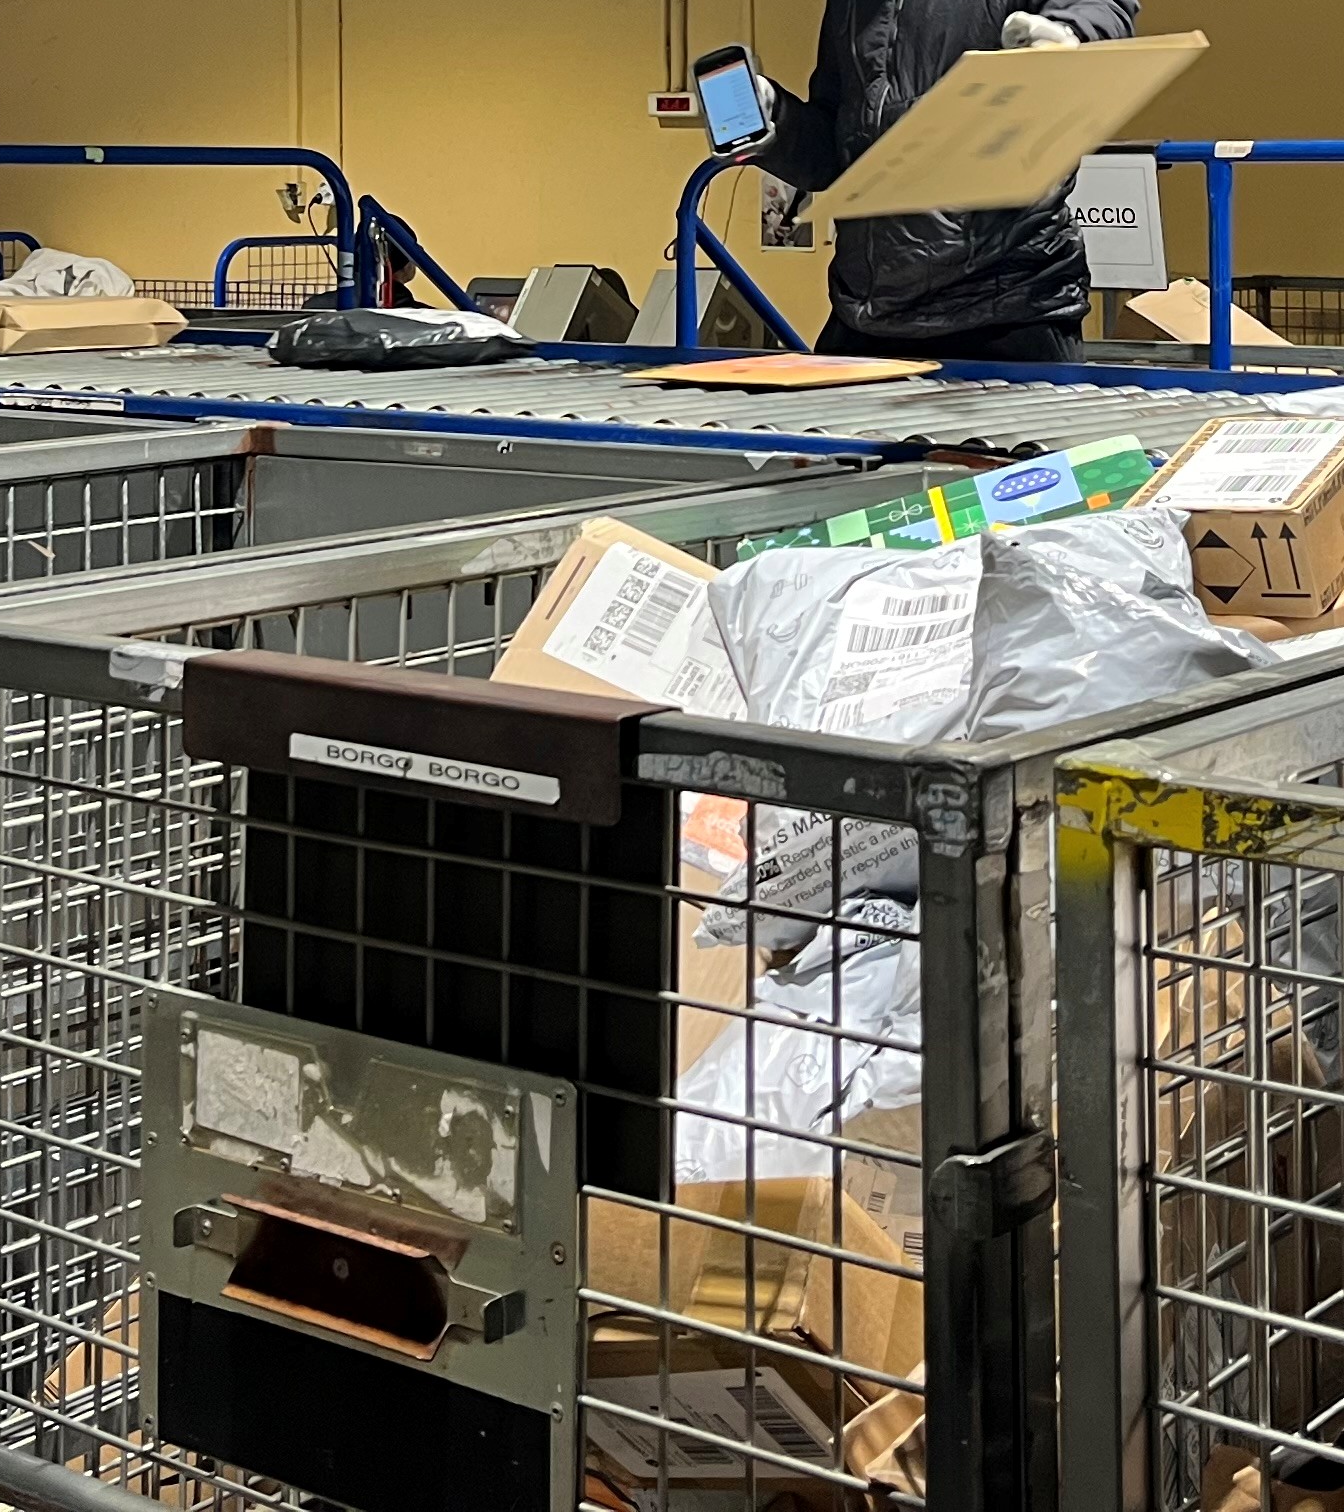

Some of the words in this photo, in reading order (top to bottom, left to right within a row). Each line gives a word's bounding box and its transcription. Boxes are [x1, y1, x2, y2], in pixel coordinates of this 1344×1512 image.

[326, 744, 413, 772] BORGO
[428, 761, 520, 791] BORGO
[758, 861, 824, 902] discarded
[823, 842, 868, 873] pastic
[781, 834, 836, 867] Recycle
[794, 877, 834, 903] reuse
[851, 844, 899, 877] recycle
